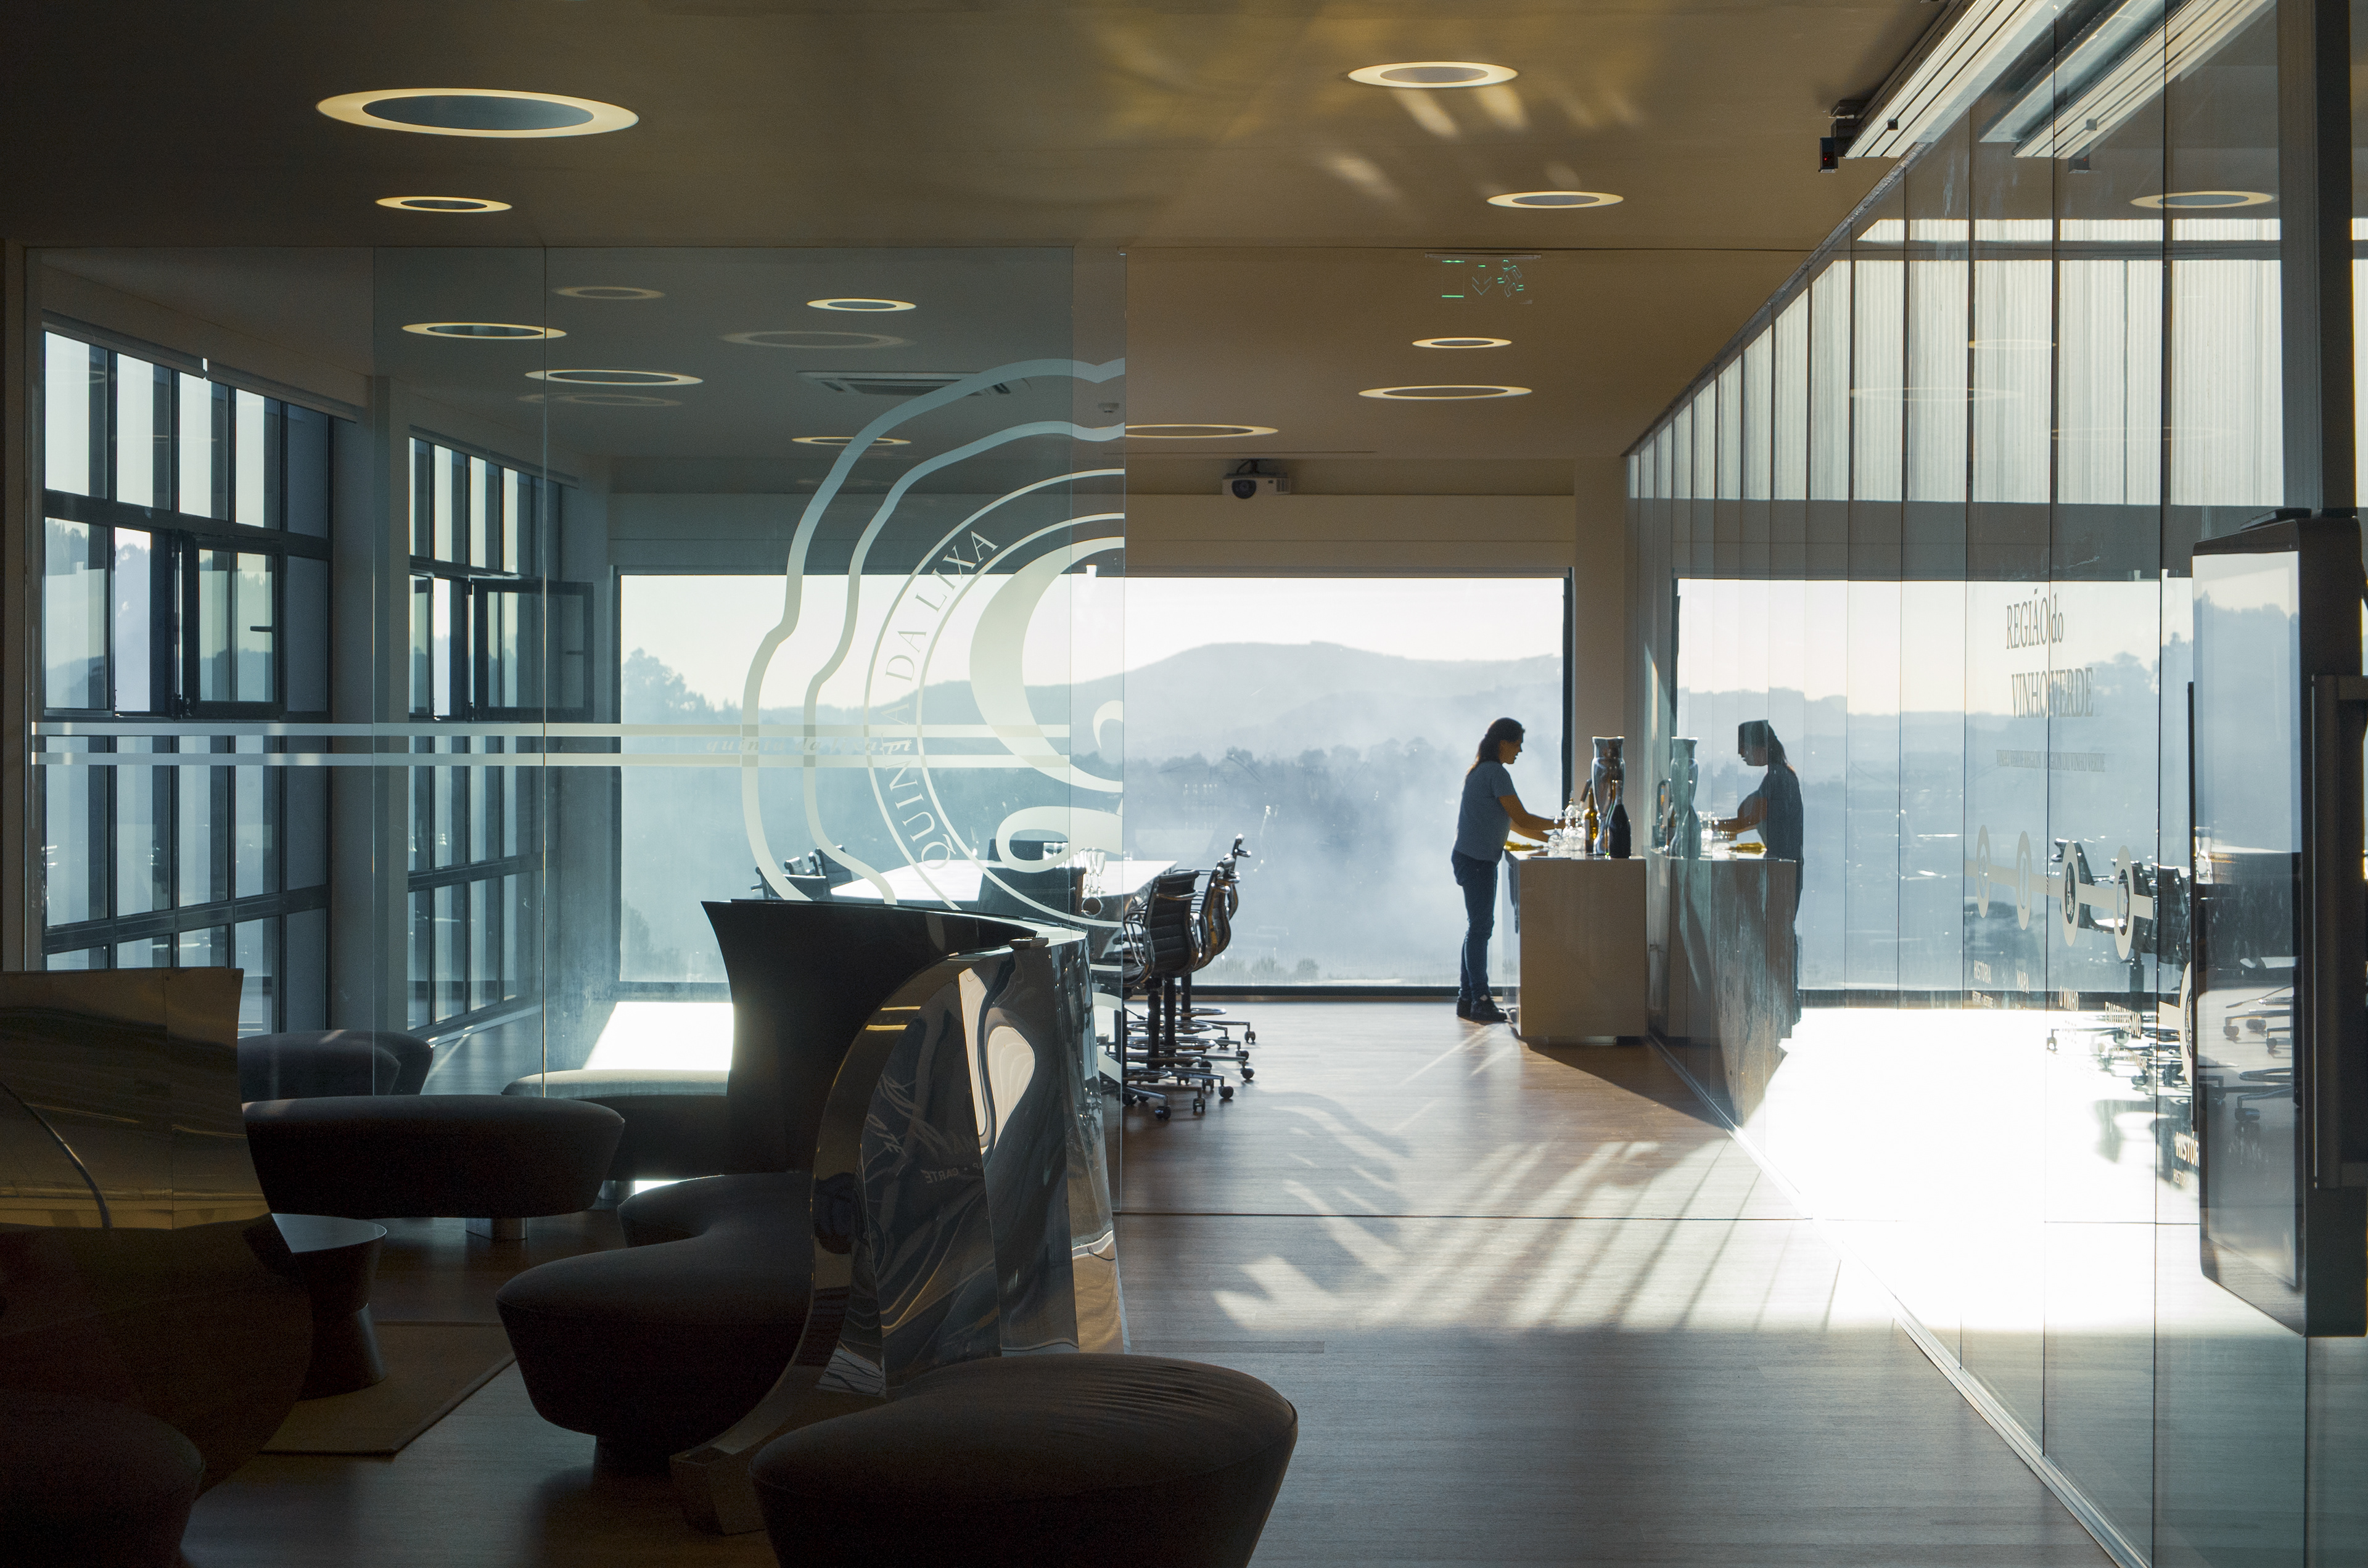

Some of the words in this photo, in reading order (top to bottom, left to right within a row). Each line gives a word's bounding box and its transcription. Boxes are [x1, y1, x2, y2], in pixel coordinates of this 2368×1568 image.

[885, 630, 927, 682] DA
[915, 530, 998, 613] LIXA
[2050, 592, 2064, 644] do
[2011, 670, 2049, 718] VINHO
[2050, 667, 2093, 717] VERDE
[2016, 969, 2029, 995] MAPA
[2063, 987, 2079, 1012] VINHO
